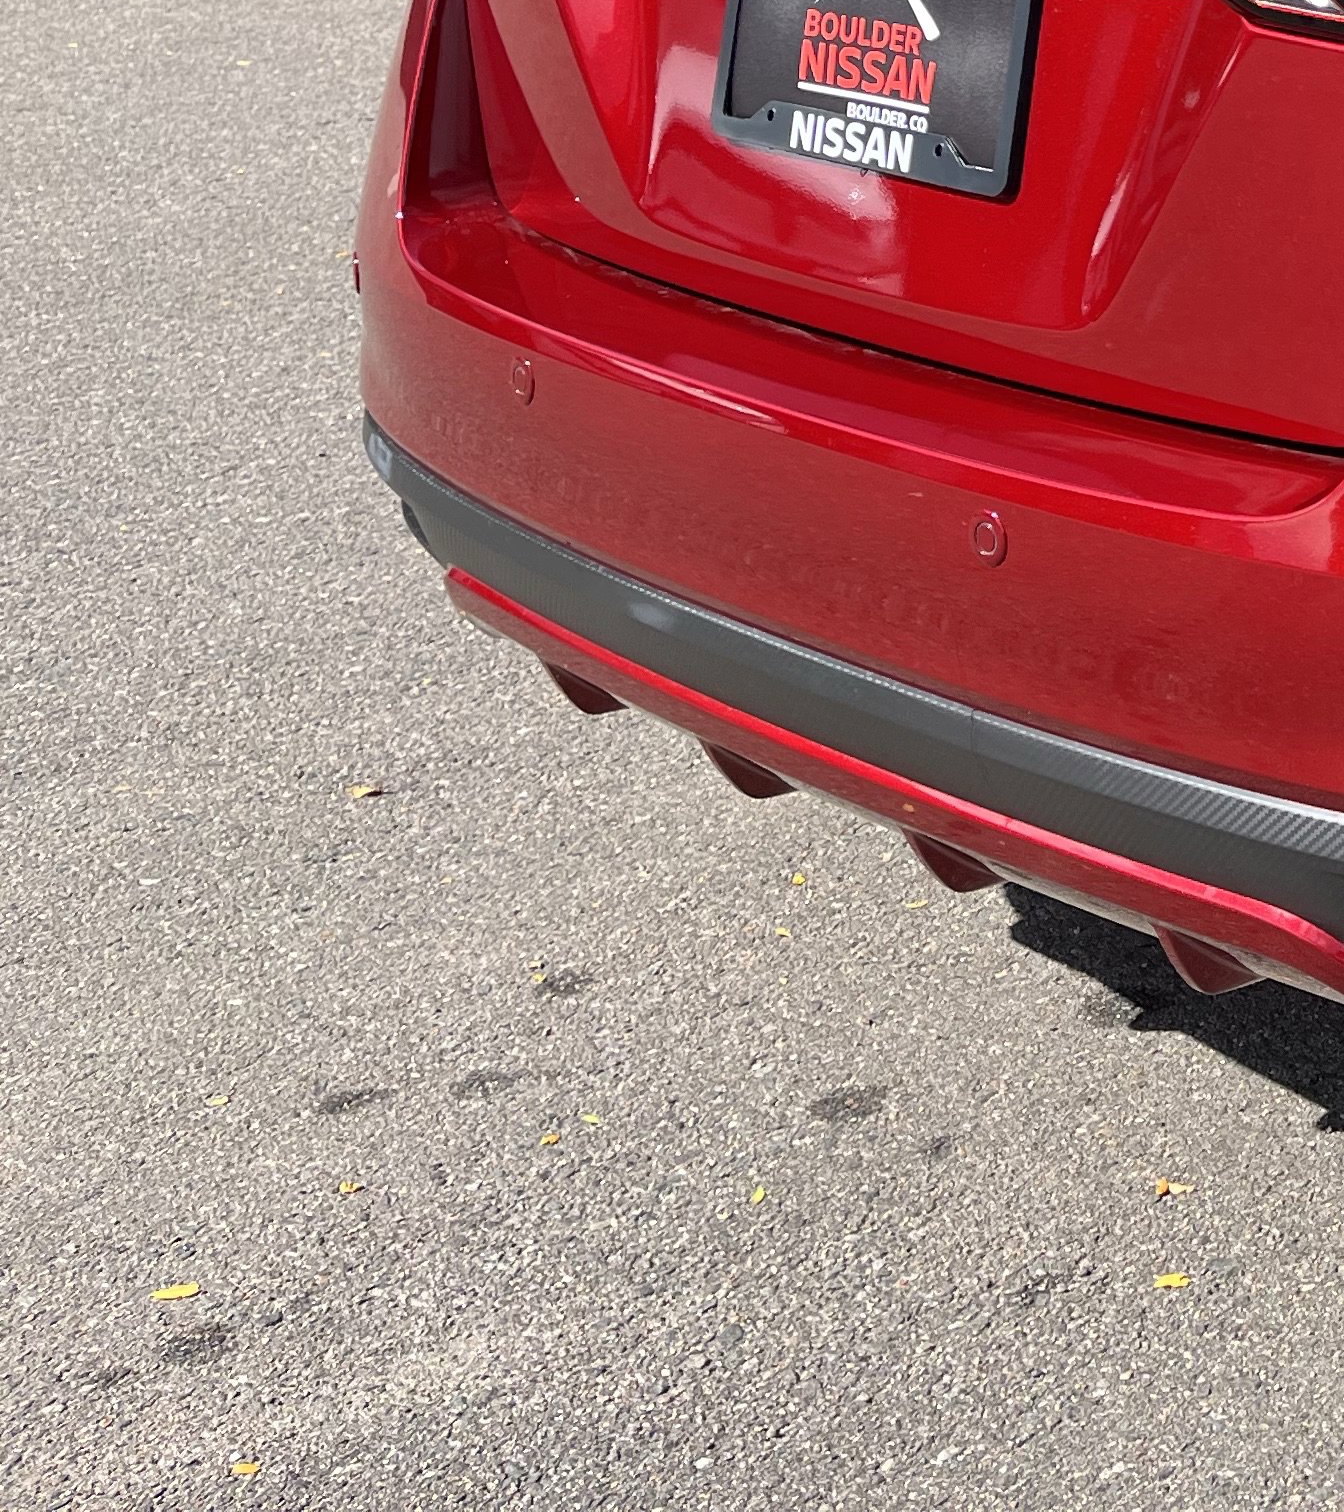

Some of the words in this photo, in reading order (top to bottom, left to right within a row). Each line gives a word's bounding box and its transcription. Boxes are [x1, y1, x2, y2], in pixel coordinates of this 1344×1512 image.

[804, 8, 923, 55] BOULDER
[799, 39, 937, 104] NISSAN
[789, 110, 914, 173] NISSAN
